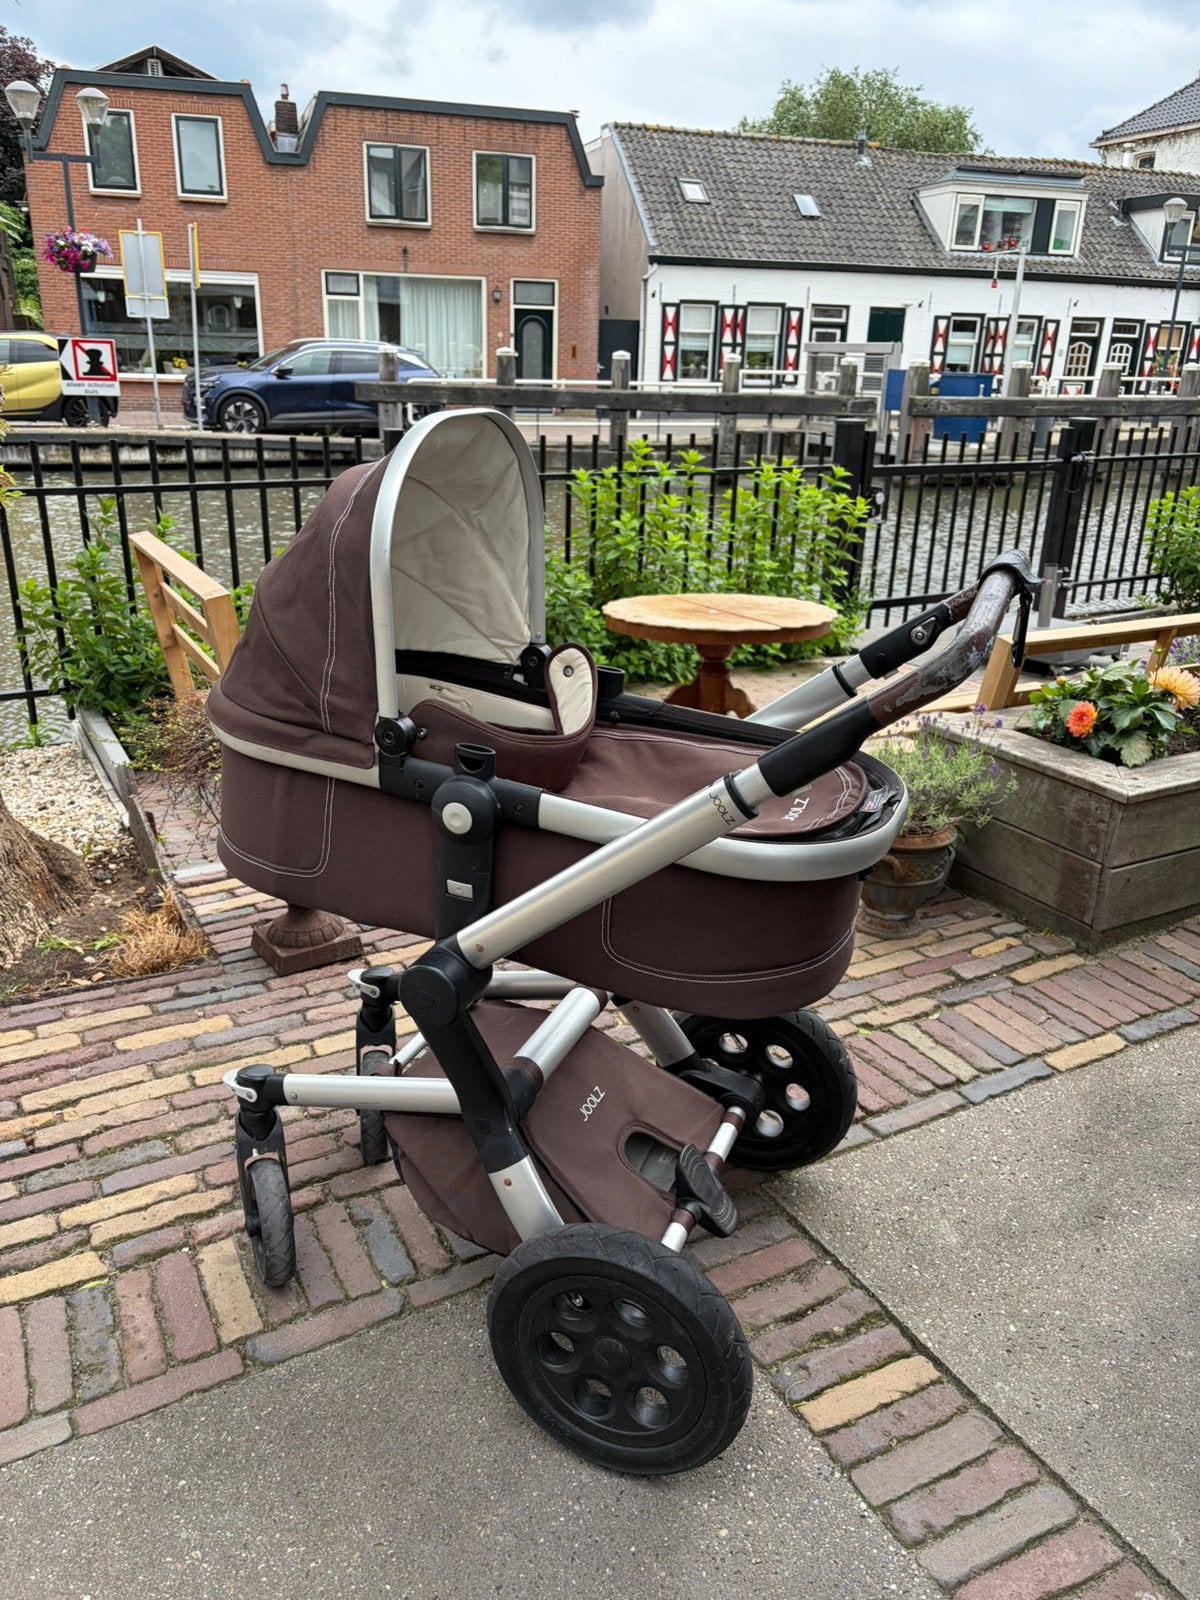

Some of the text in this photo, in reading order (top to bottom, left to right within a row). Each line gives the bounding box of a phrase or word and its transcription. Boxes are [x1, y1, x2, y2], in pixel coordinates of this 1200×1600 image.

[709, 793, 736, 826] JOOLZ
[781, 797, 810, 822] JOOLZ
[580, 1086, 606, 1122] JOOLZ
